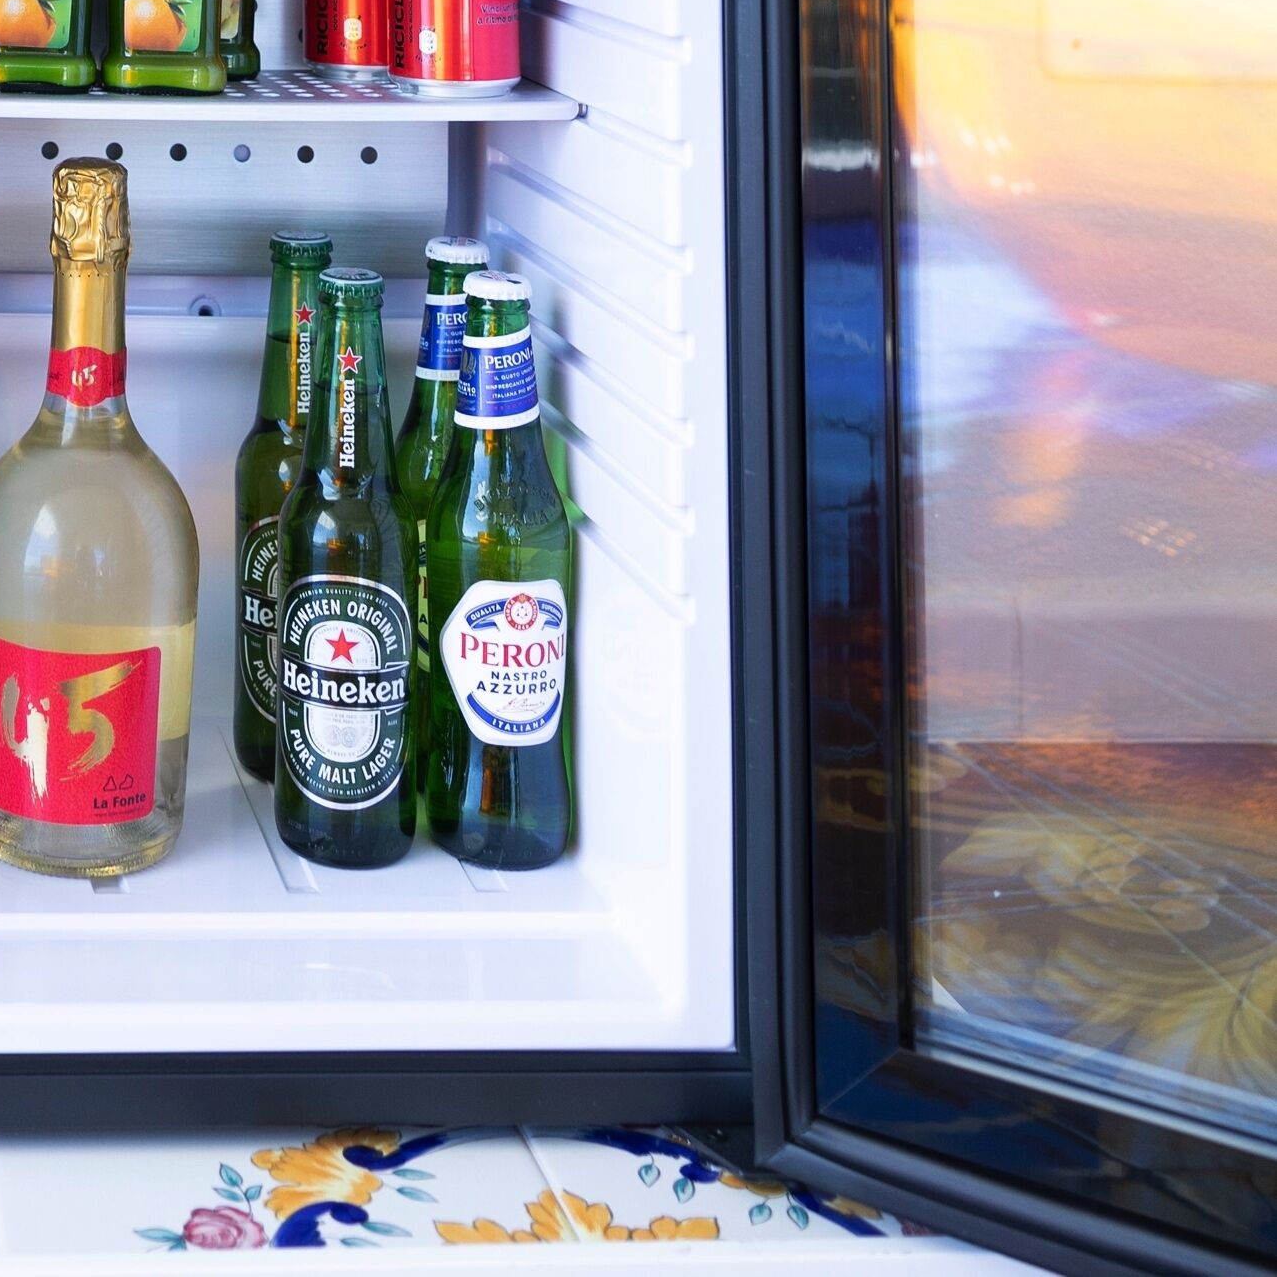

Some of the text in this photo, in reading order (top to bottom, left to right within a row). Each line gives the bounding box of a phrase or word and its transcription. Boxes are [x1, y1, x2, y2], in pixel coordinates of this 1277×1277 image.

[297, 333, 311, 414] Heineken
[484, 347, 530, 370] PERONI
[339, 379, 355, 469] Heineken
[289, 599, 341, 645] HEINEKEN
[347, 601, 398, 655] ORIGINAL
[460, 632, 564, 668] PERONI
[283, 658, 405, 704] Heineken
[477, 678, 556, 695] AZZURRO
[491, 670, 547, 681] NASTRO
[492, 718, 545, 732] ITALIANA
[290, 728, 316, 770] PURE
[318, 763, 356, 785] MALT
[361, 737, 396, 780] LAGER
[93, 793, 146, 809] La Fonte
